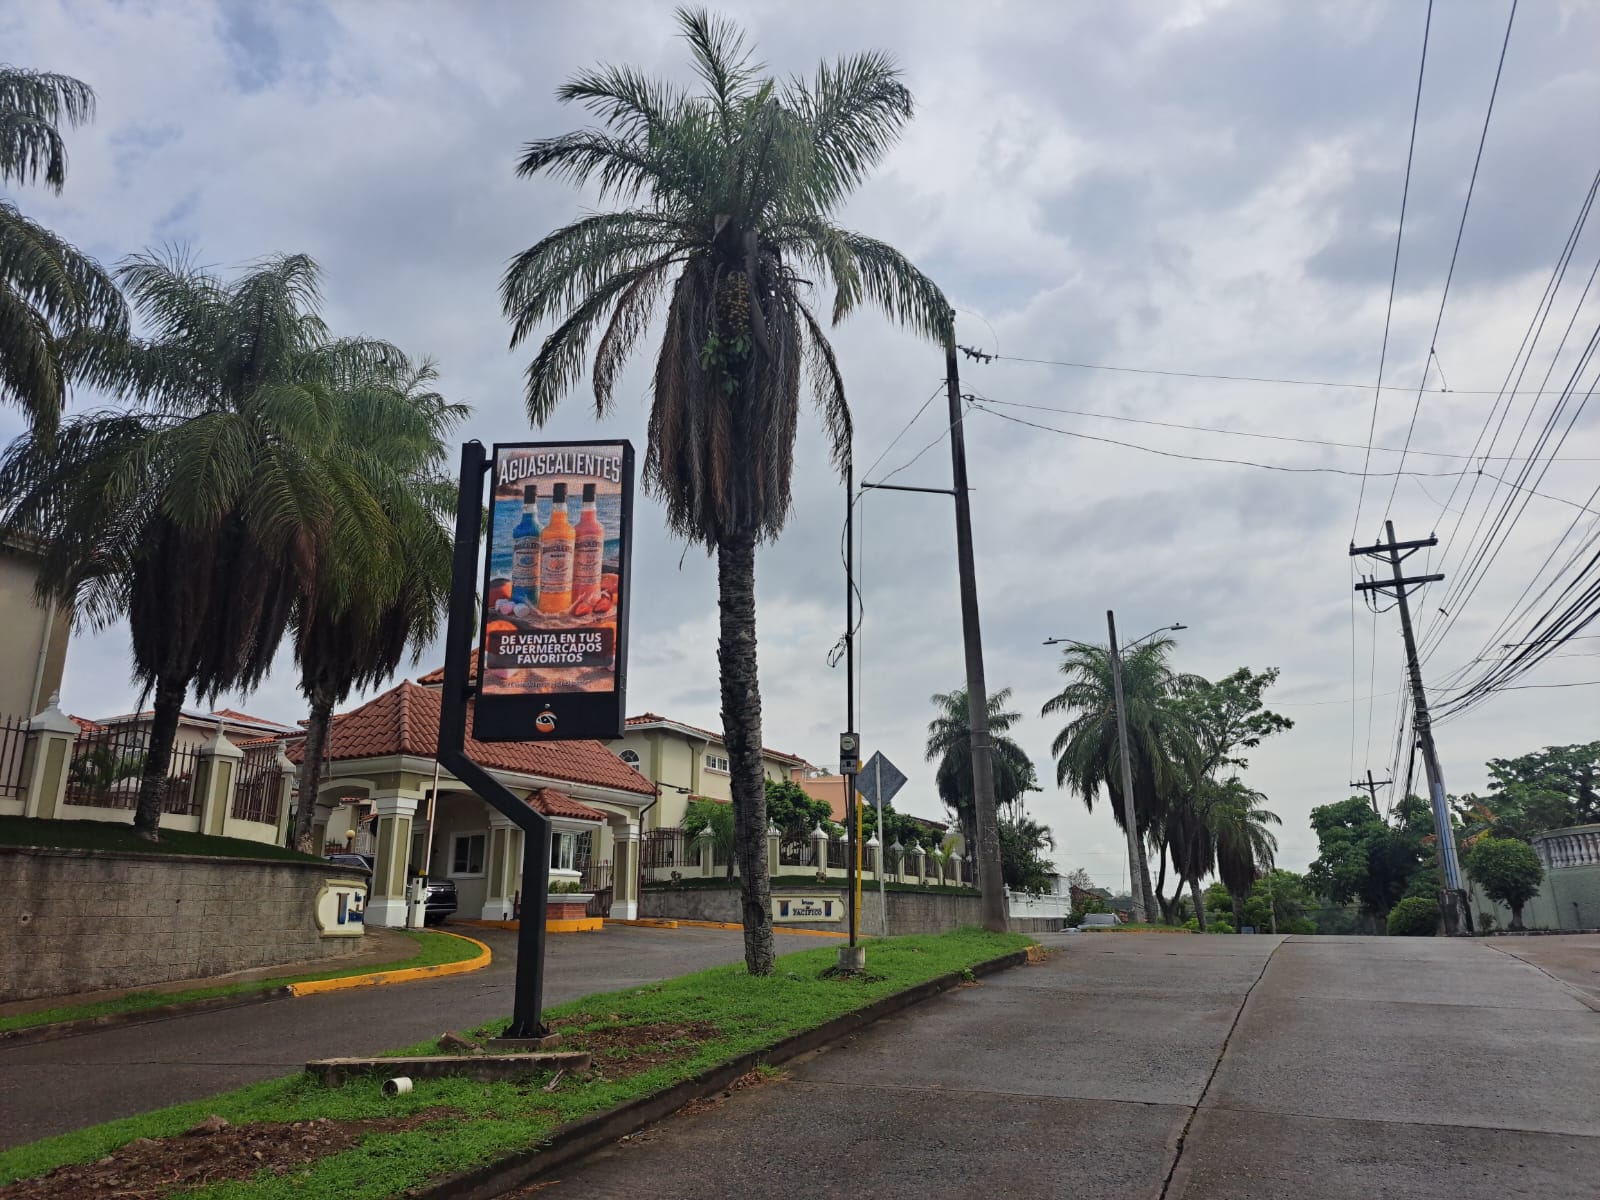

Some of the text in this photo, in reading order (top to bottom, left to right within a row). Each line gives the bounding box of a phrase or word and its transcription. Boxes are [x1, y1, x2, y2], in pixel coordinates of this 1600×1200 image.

[498, 453, 620, 486] AGUASCALIENTES
[501, 632, 601, 645] DE VENTA EN TUS
[499, 643, 602, 655] SUPERMERCADOS
[517, 653, 583, 664] FAVORITOS
